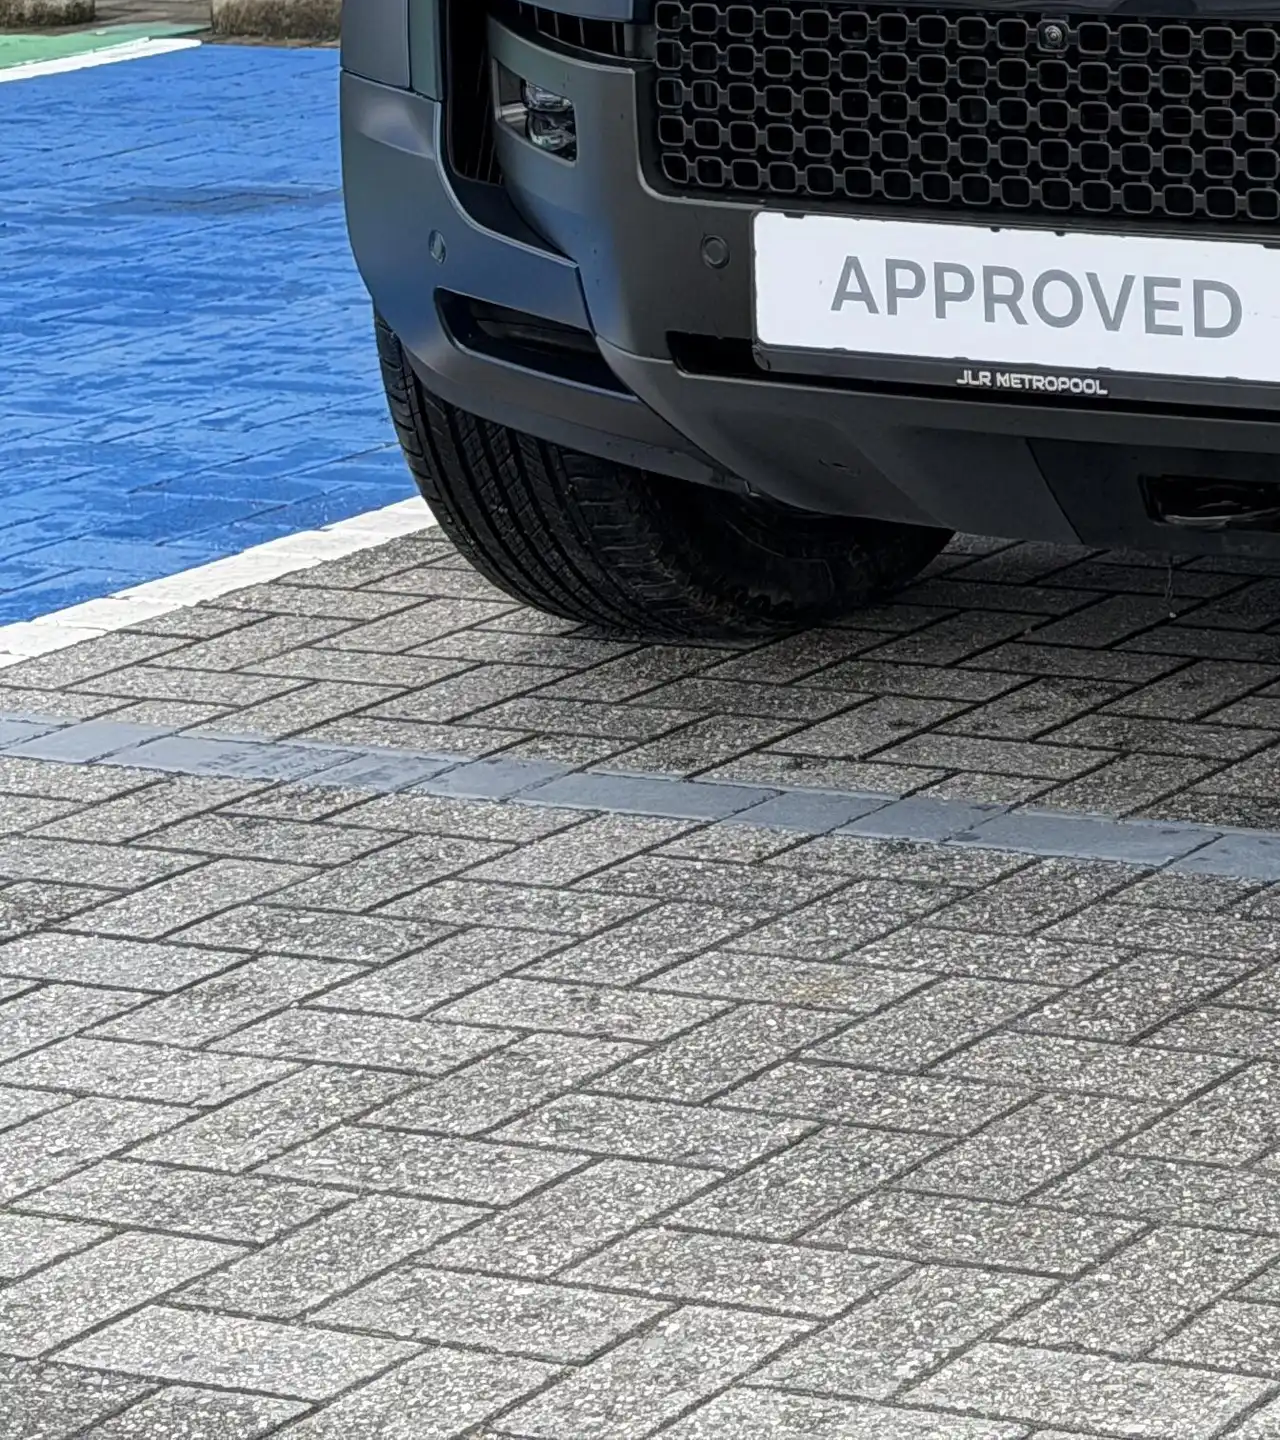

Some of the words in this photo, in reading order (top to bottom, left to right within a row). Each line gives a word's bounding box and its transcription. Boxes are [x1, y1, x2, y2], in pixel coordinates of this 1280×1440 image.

[830, 255, 1243, 338] APPROVED
[956, 369, 992, 387] JLR
[995, 372, 1109, 396] METROPOOL
